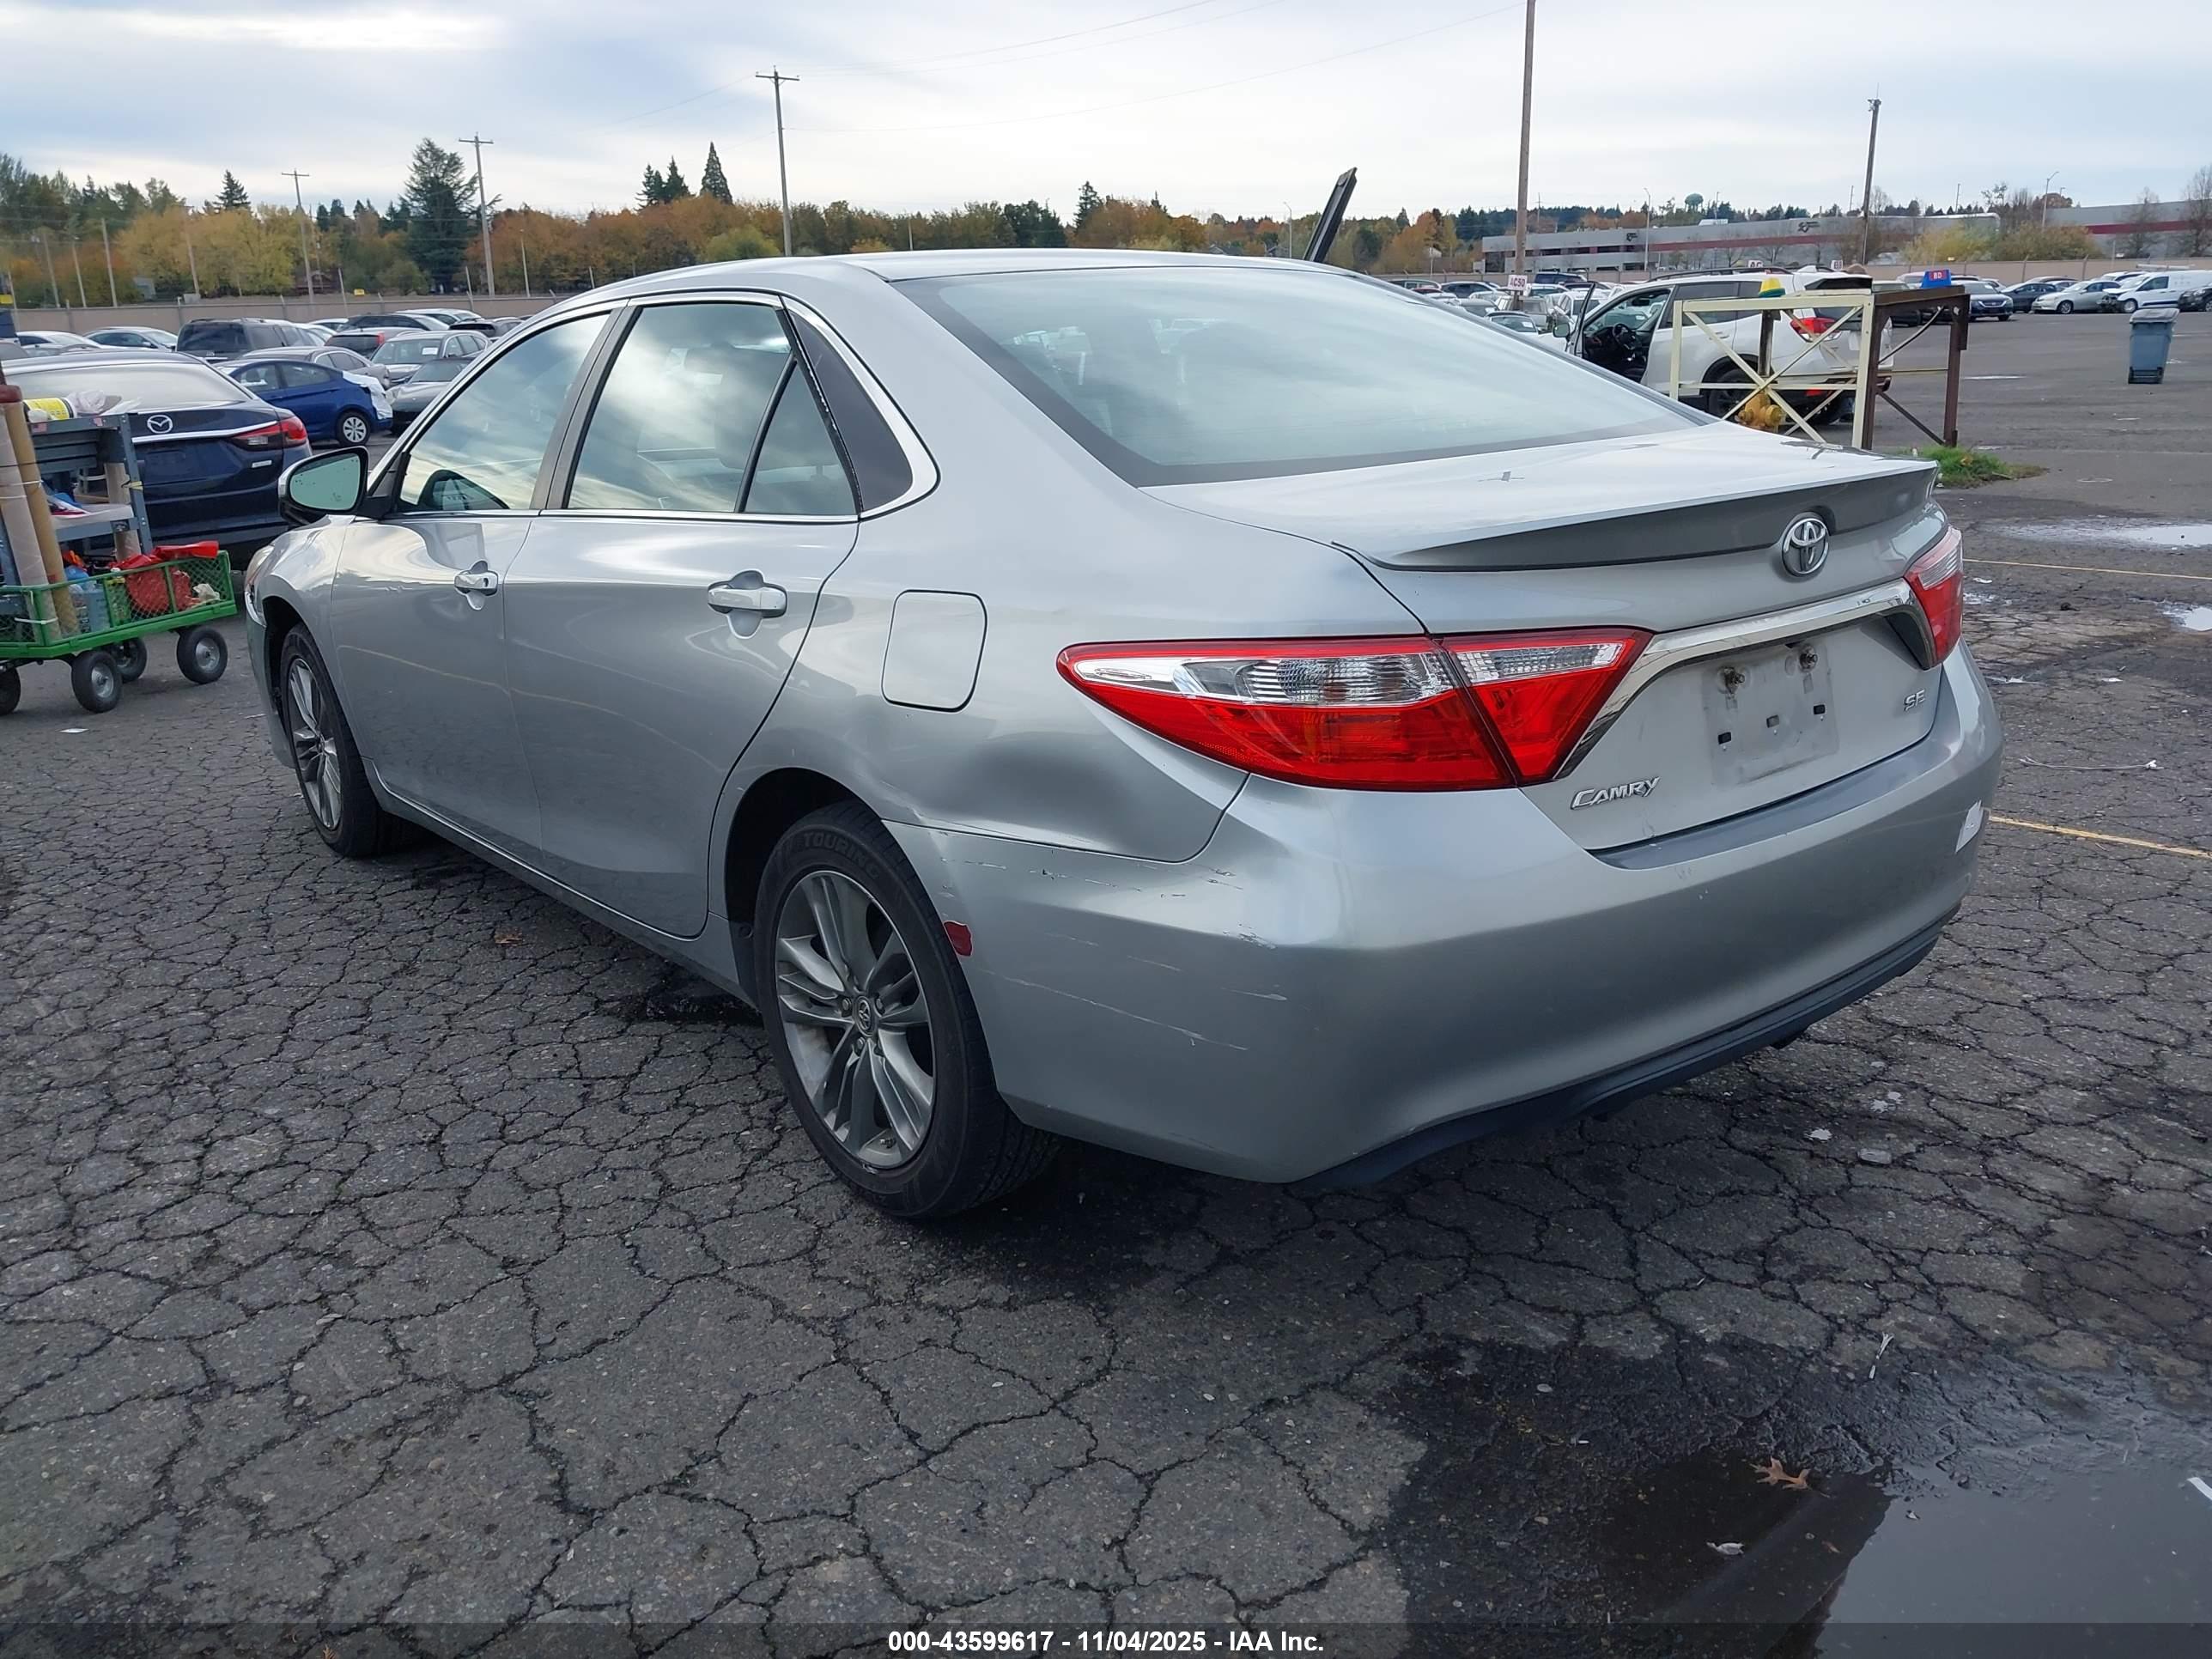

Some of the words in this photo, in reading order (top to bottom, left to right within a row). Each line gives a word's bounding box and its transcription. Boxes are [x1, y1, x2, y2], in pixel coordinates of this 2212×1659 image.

[1904, 689, 1926, 711] SE
[1571, 776, 1660, 810] CAMRY
[804, 831, 880, 879] TOURING
